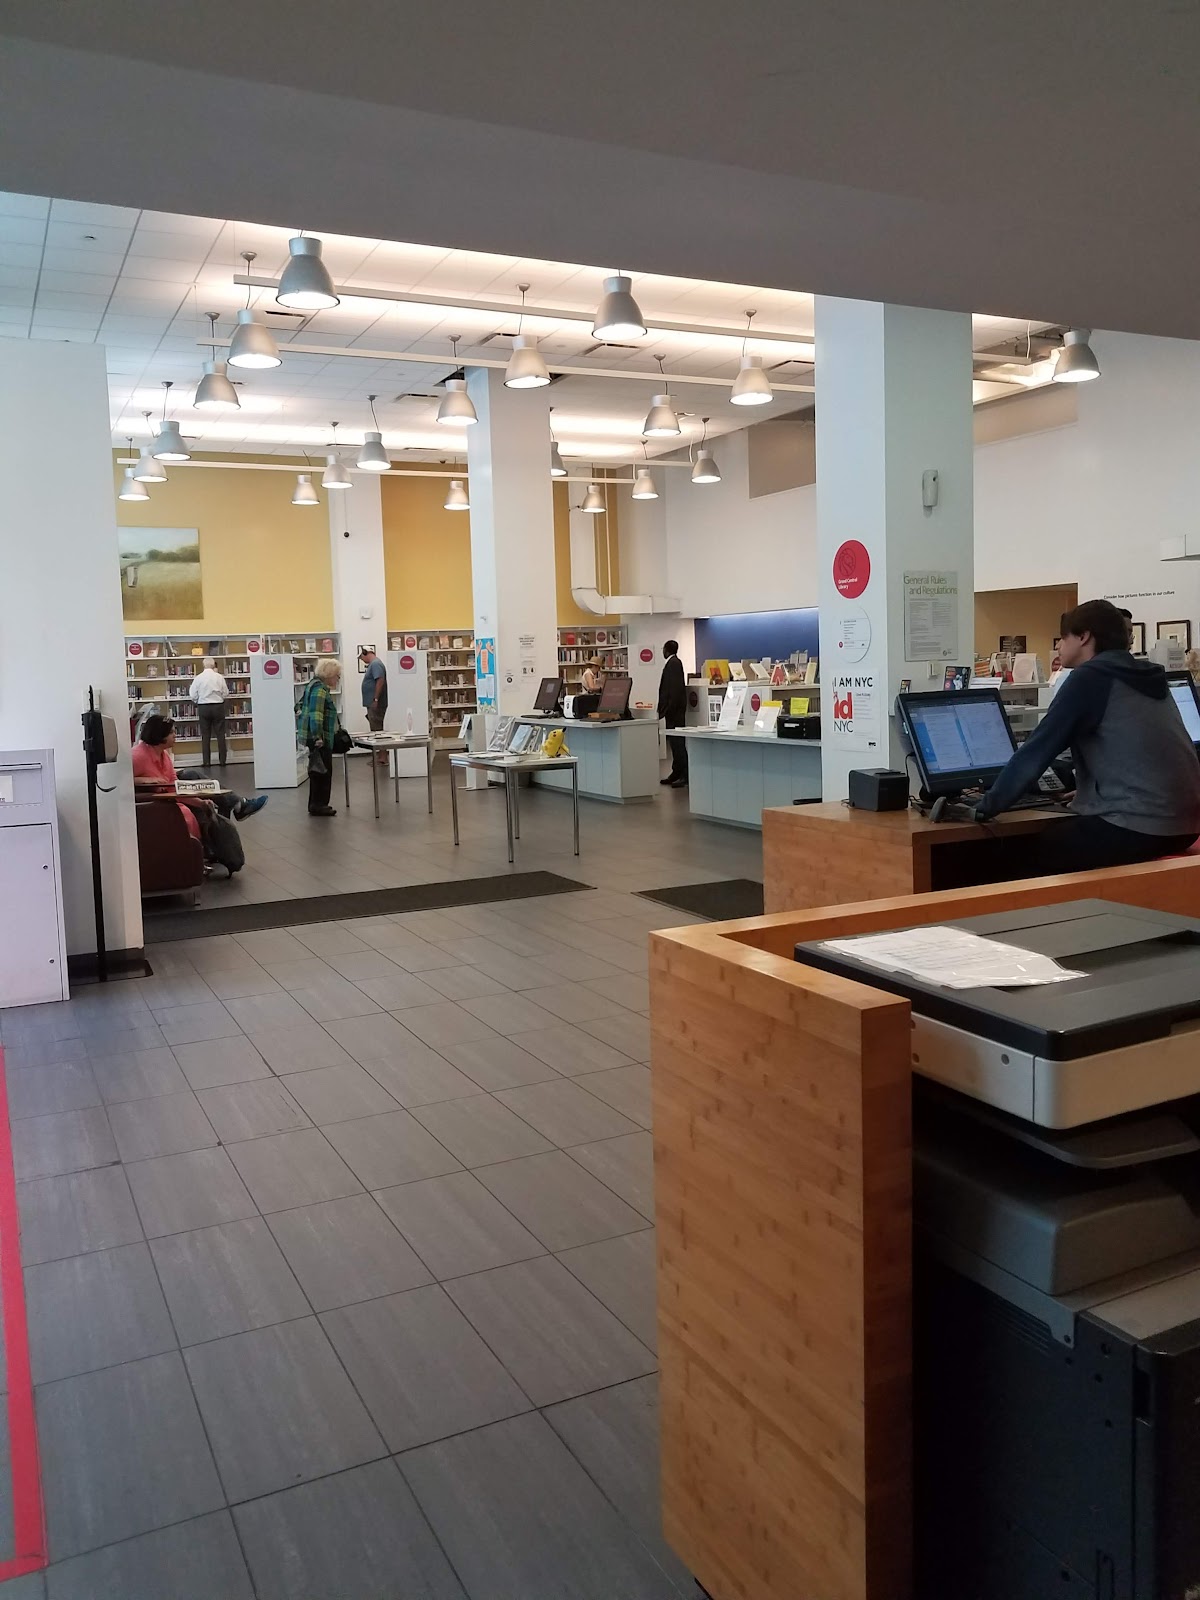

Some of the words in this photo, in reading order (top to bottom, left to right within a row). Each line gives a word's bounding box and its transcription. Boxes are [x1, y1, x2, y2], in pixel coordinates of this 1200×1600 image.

[903, 575, 929, 585] General
[930, 575, 947, 585] Rules
[909, 586, 922, 595] and
[922, 586, 958, 597] Regulations
[834, 676, 837, 687] I
[839, 676, 852, 687] AM
[855, 676, 873, 687] NYC
[834, 720, 853, 733] NYC
